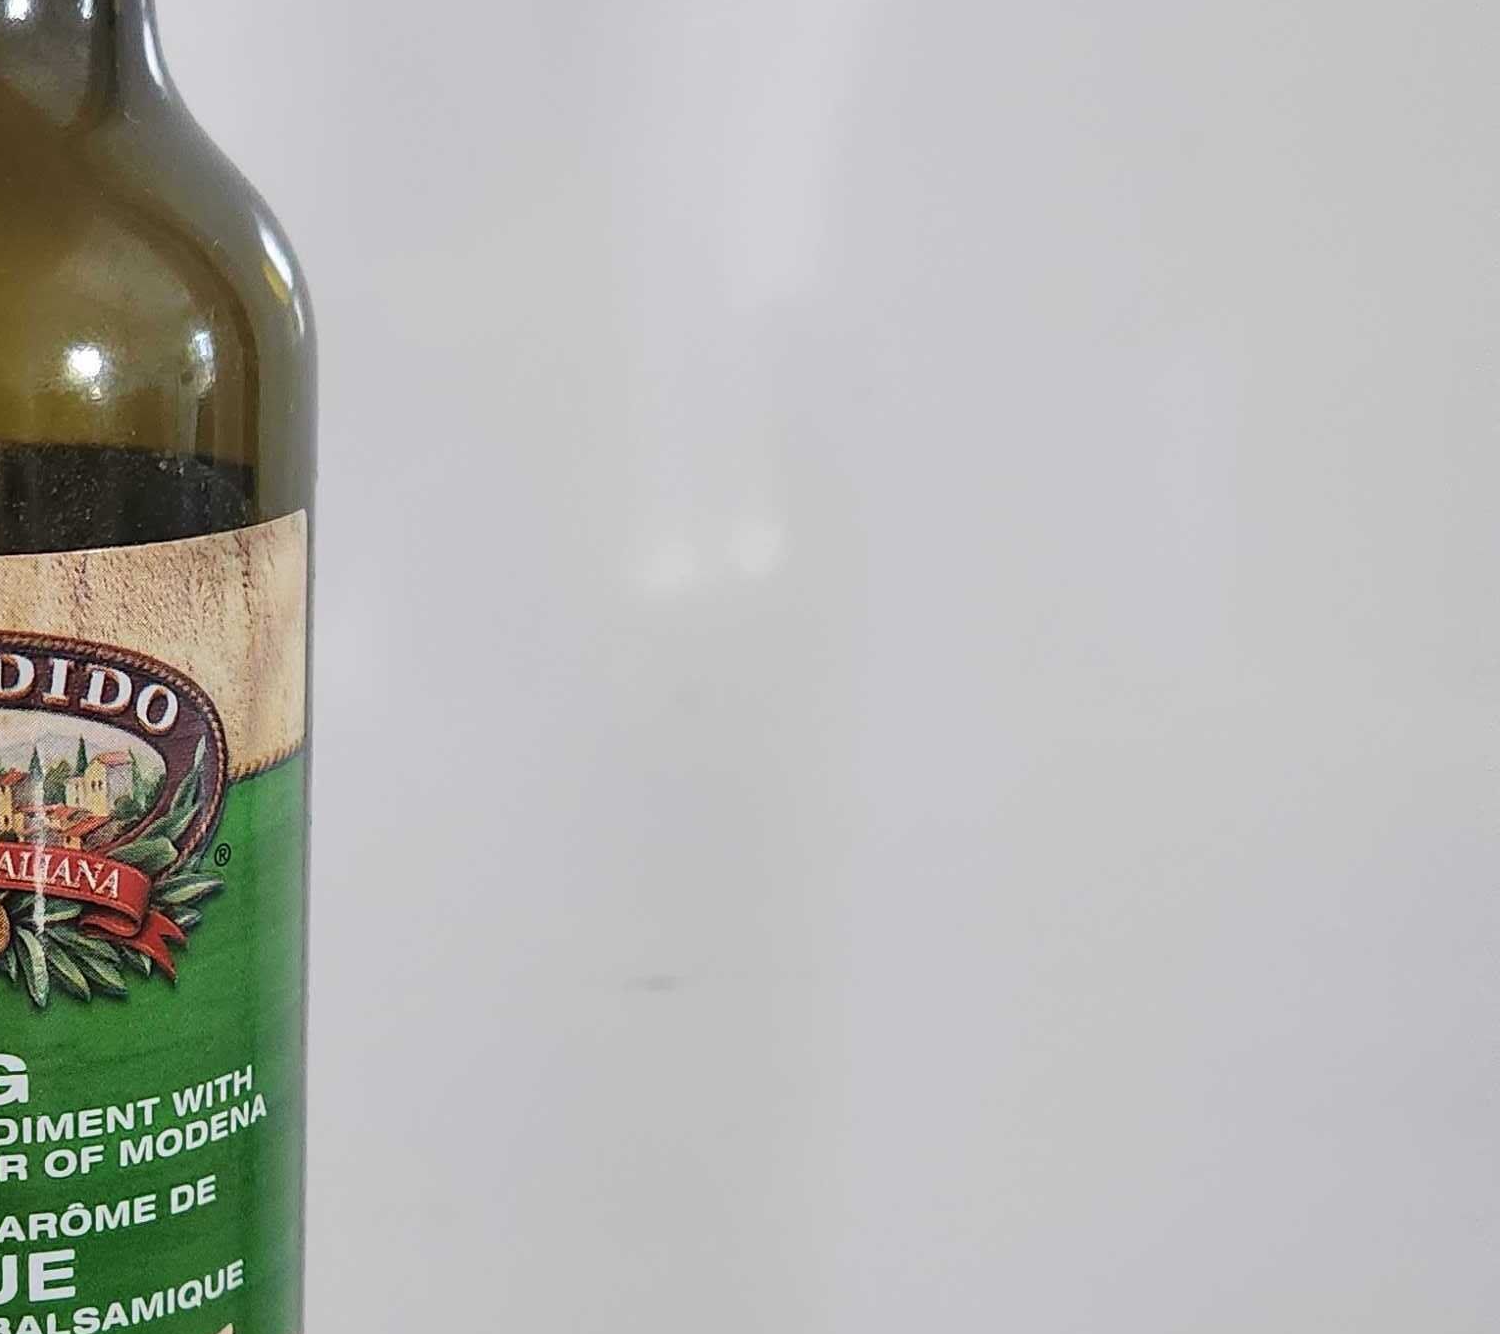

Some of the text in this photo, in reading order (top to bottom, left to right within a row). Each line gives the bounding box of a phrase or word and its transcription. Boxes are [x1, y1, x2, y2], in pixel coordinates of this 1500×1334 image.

[172, 1064, 253, 1118] WITH
[44, 1144, 105, 1179] OF
[119, 1093, 267, 1167] MODENA
[170, 1174, 217, 1215] DE
